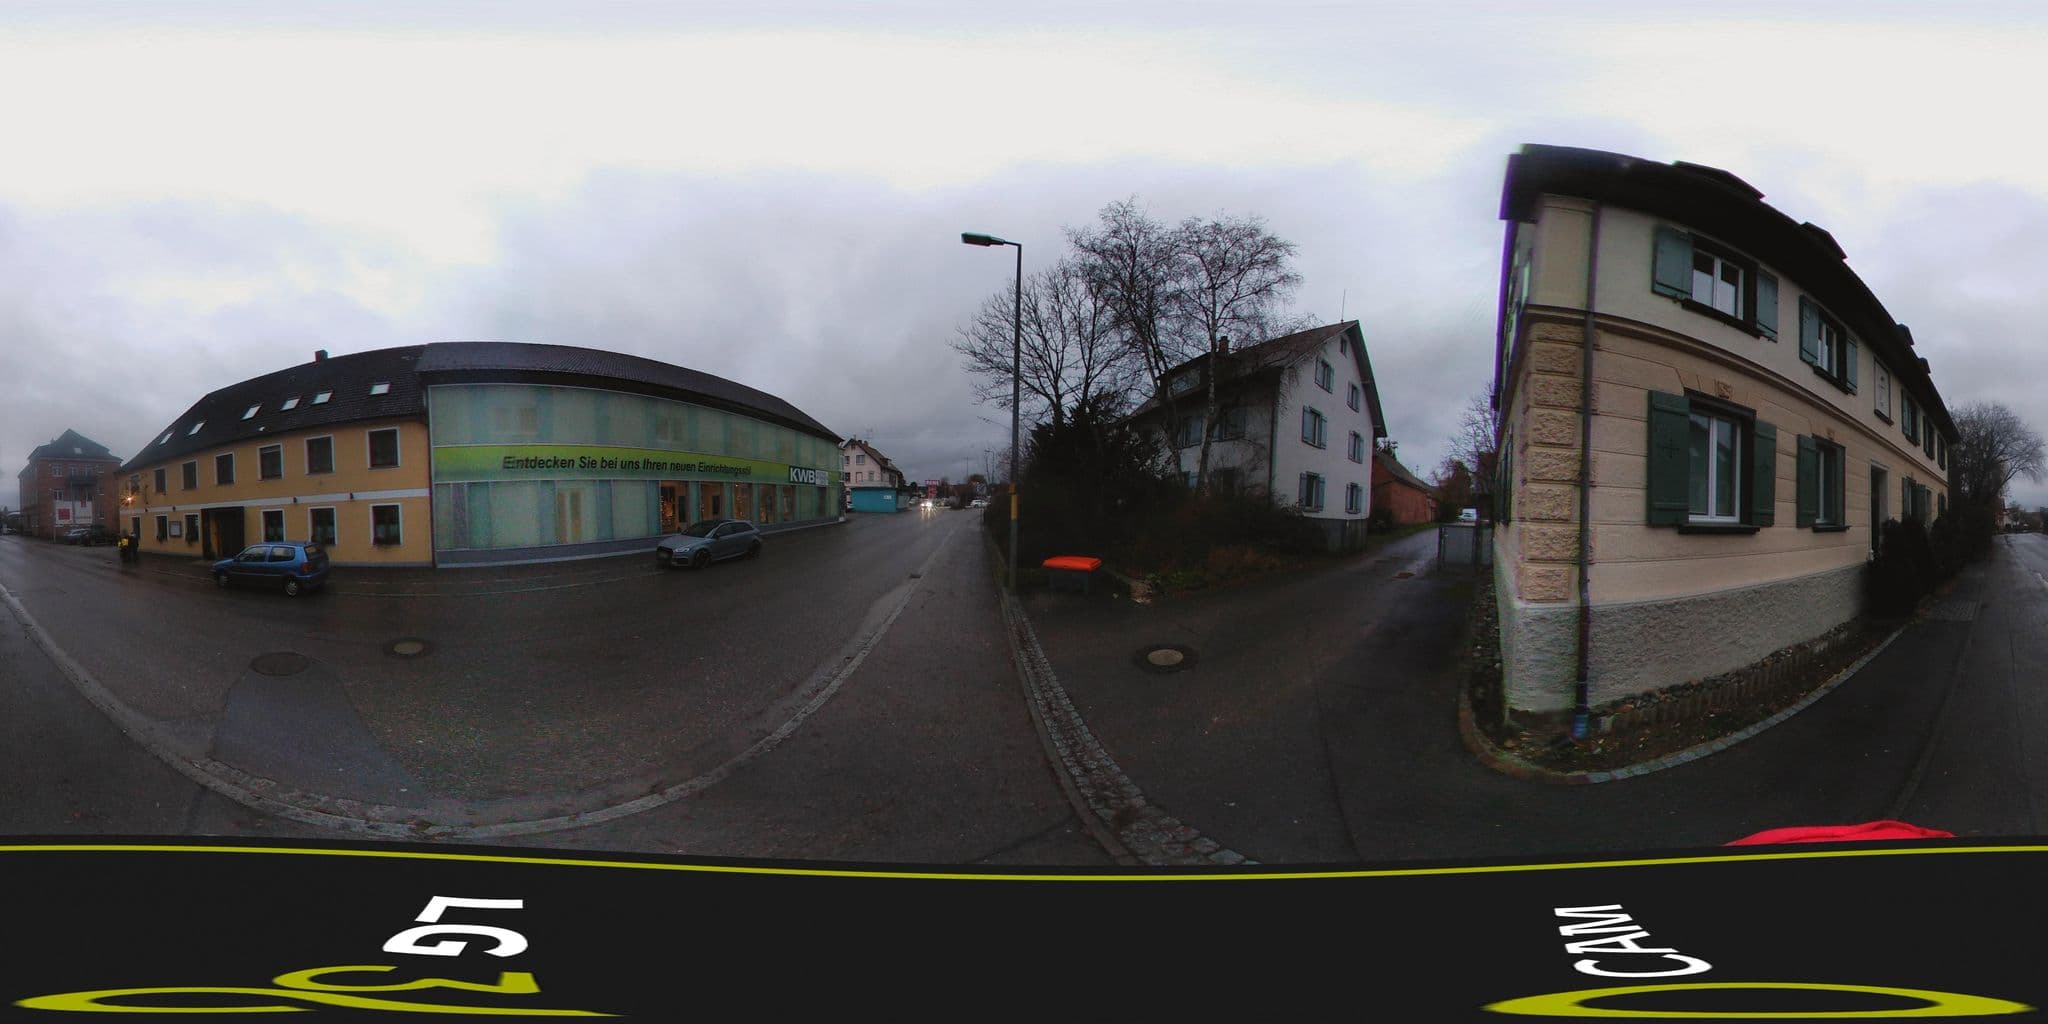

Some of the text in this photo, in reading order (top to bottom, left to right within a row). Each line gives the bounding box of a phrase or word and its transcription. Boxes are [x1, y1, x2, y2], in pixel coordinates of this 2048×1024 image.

[502, 456, 575, 469] Entdecken
[578, 456, 597, 469] Sie
[600, 457, 618, 469] bei
[620, 459, 640, 470] uns
[643, 458, 668, 471] Ihren
[670, 462, 696, 472] neuen
[789, 467, 815, 483] KWB
